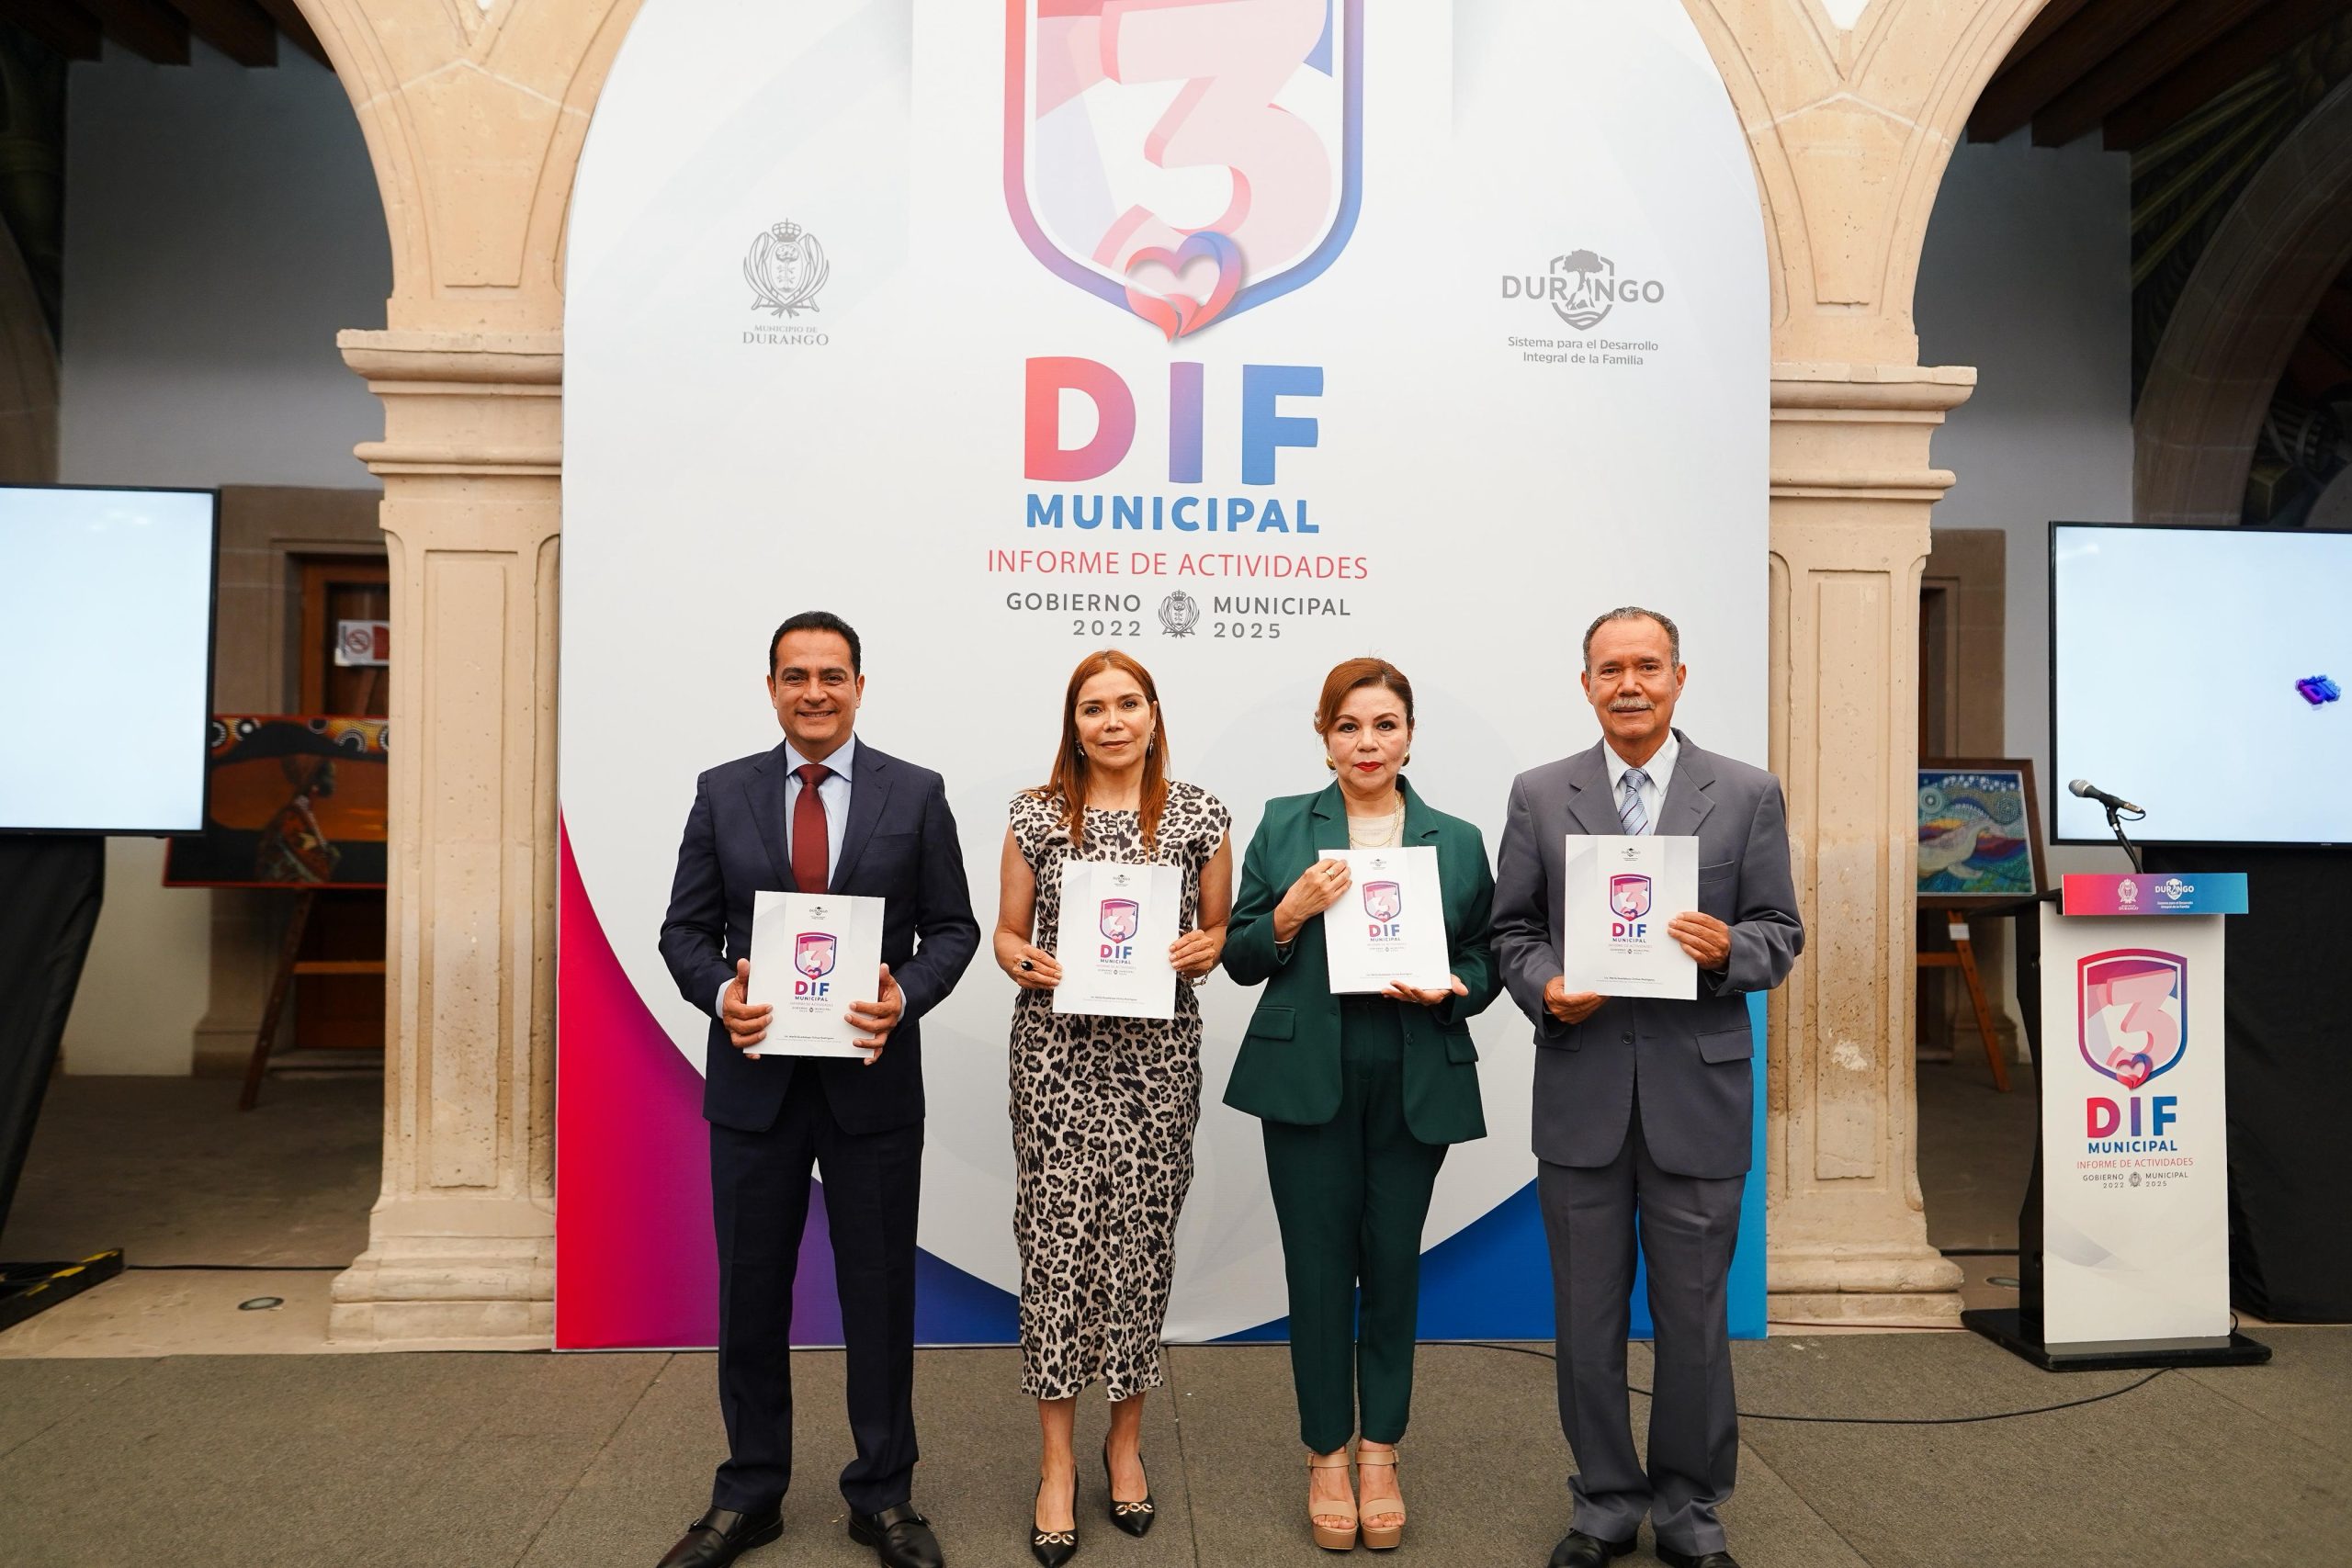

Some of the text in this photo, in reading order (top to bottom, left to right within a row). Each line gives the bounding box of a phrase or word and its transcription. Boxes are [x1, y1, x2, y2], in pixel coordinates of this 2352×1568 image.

[754, 324, 803, 333] MUNICIPIO
[743, 332, 829, 345] DURANGO
[1508, 336, 1658, 351] Sistema para el Desarrollo
[1524, 352, 1644, 365] Integral de la Familia
[1024, 356, 1324, 485] DIF
[1026, 493, 1319, 534] MUNICIPAL
[989, 549, 1368, 580] INFORME DE ACTIVIDADES
[1006, 592, 1351, 616] GOBIERNO MUNICIPAL
[1073, 620, 1282, 639] 2022 2025
[1369, 924, 1400, 937] DIF
[1611, 922, 1646, 937] DIF
[1100, 944, 1133, 959] DIF
[795, 981, 830, 996] DIF
[2087, 1096, 2177, 1138] DIF
[2088, 1140, 2177, 1154] MUNICIPAL
[2077, 1157, 2193, 1168] INFORME DE ACTIVIDADES
